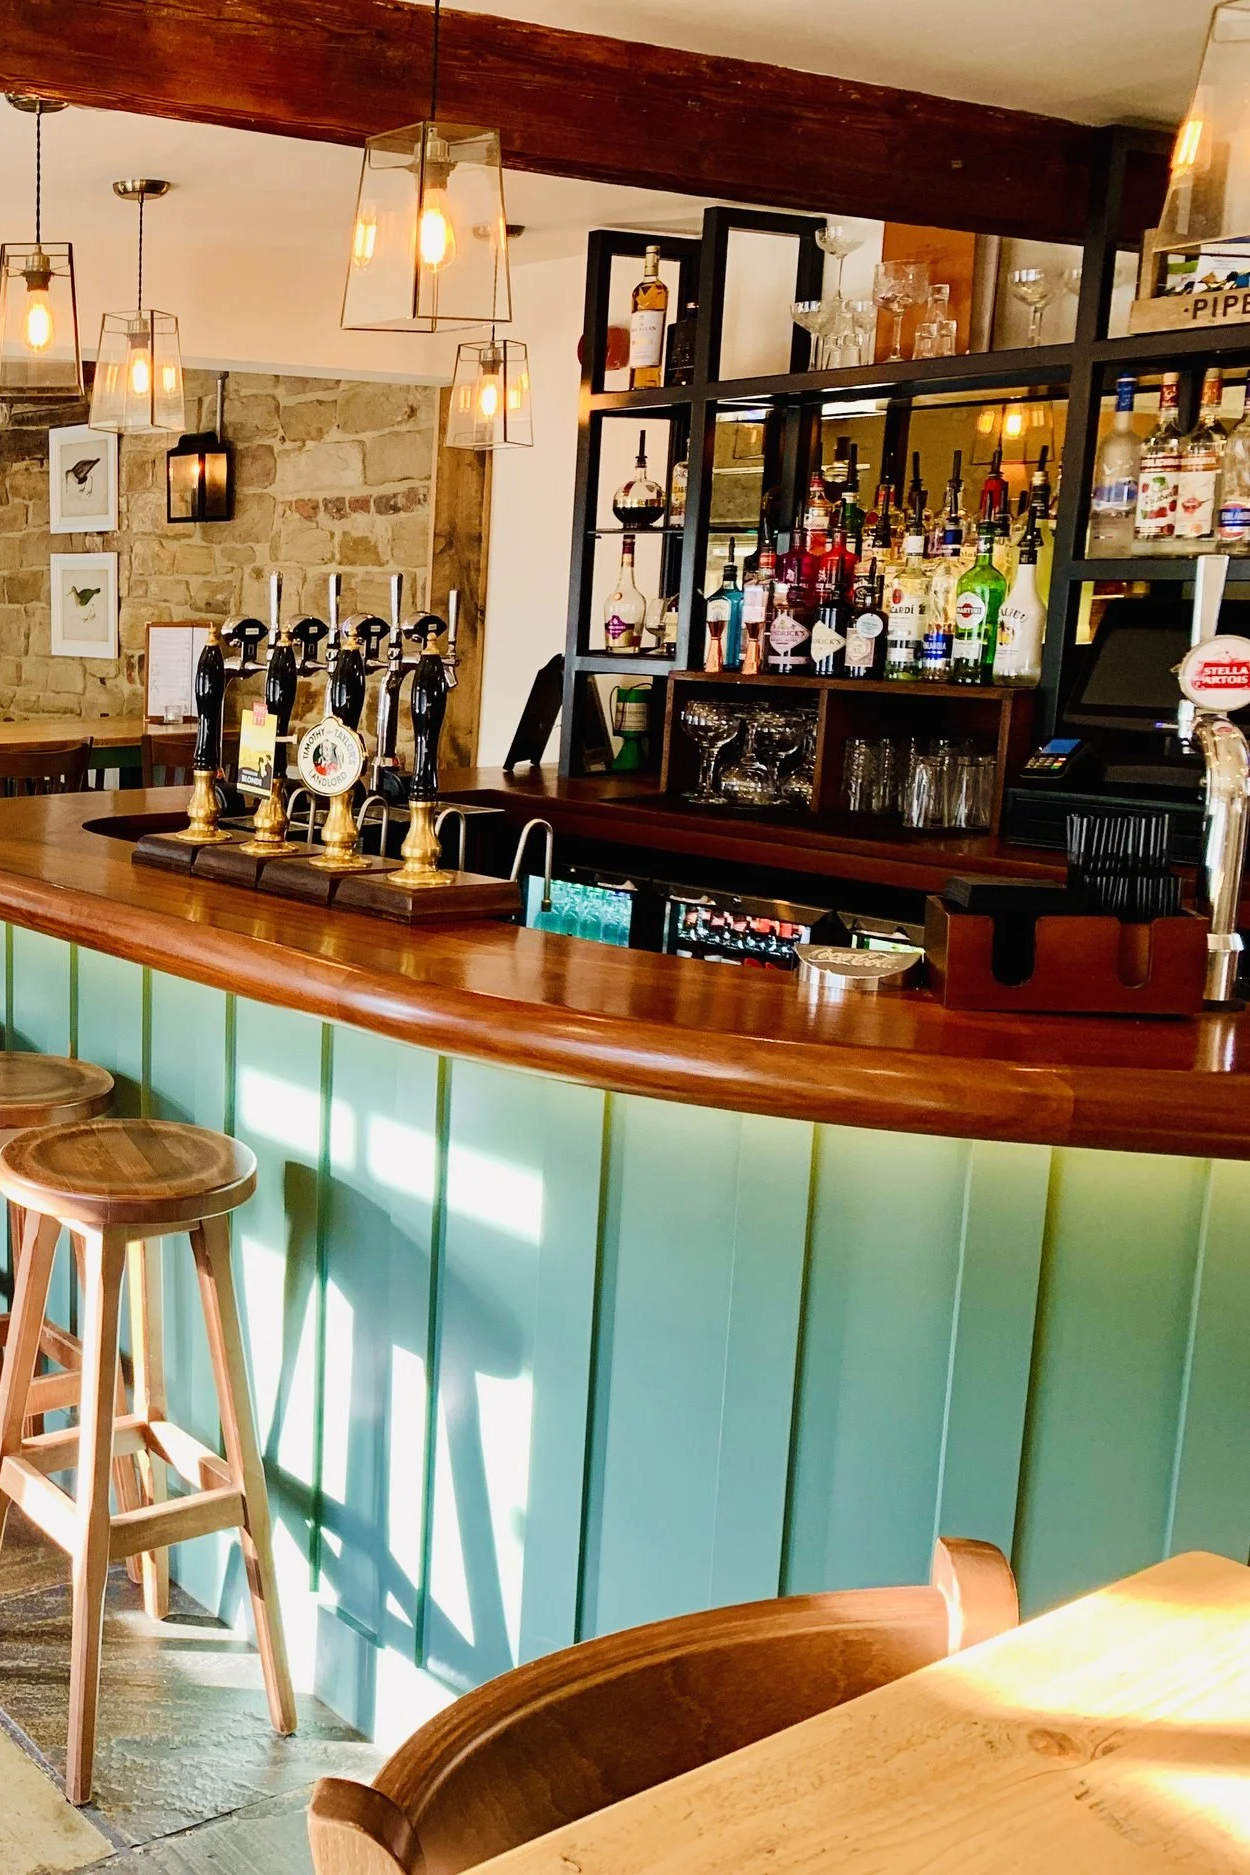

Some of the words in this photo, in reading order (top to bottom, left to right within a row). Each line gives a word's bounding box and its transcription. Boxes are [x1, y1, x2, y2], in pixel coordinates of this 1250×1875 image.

[1203, 666, 1249, 676] STELLA
[1203, 675, 1249, 684] ARTOIS
[302, 728, 325, 760] TIMOTHY
[308, 769, 348, 788] LANDLORD
